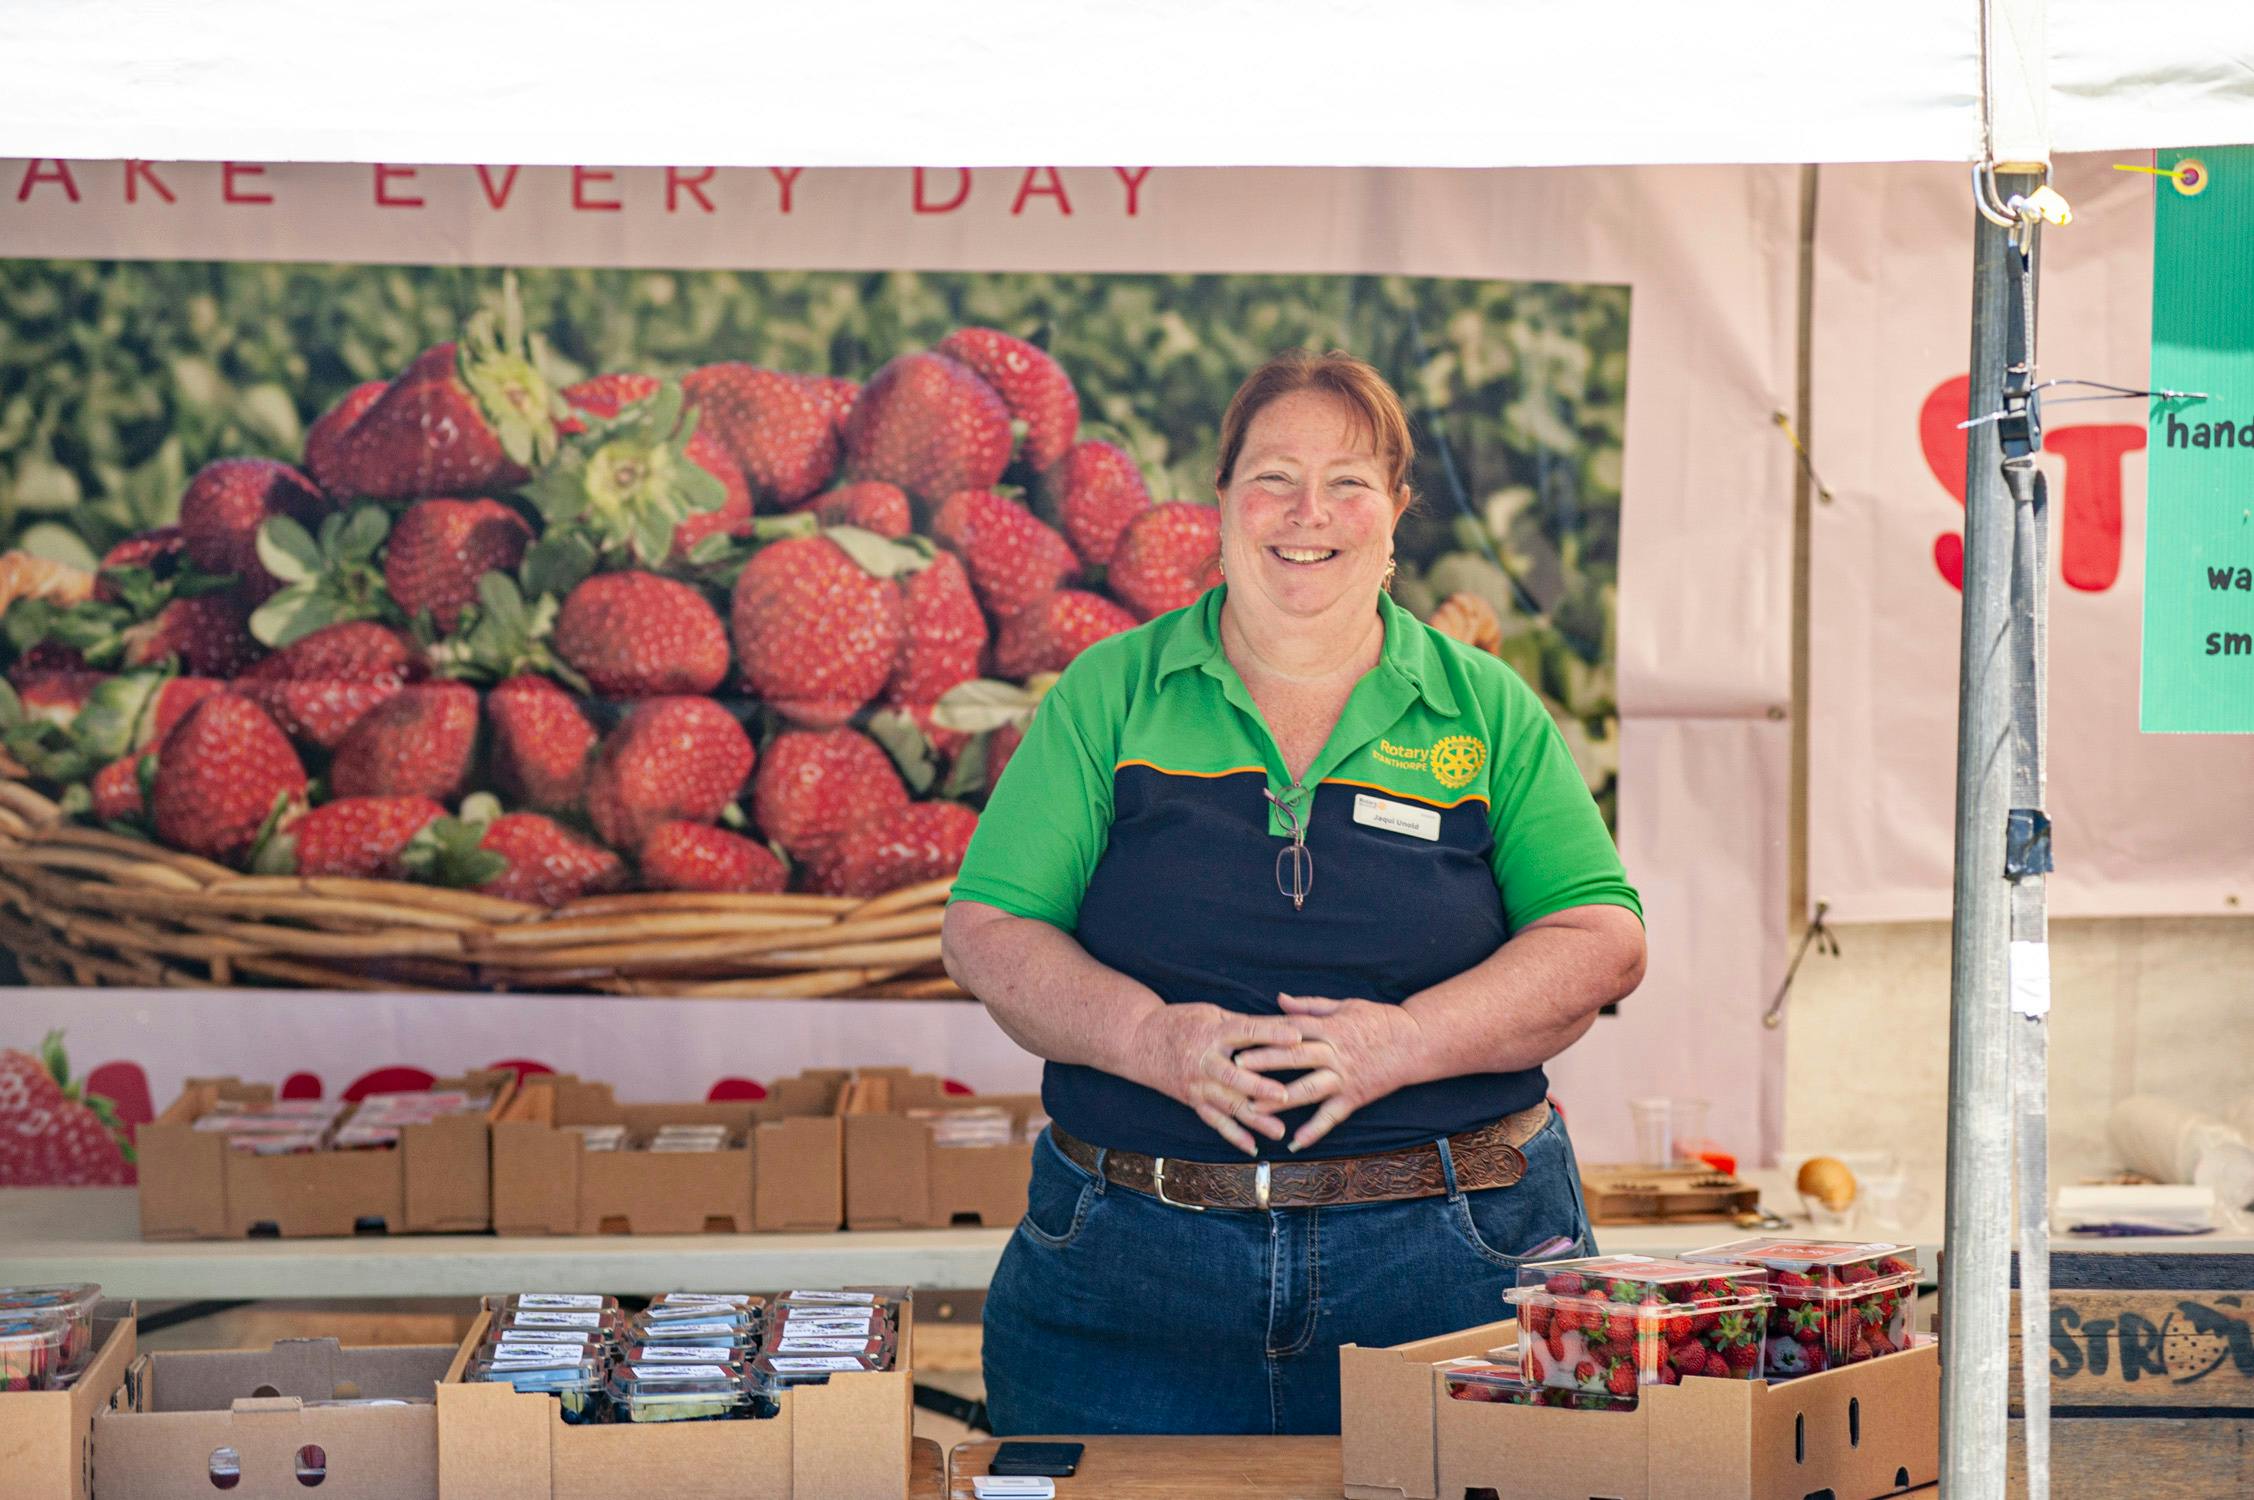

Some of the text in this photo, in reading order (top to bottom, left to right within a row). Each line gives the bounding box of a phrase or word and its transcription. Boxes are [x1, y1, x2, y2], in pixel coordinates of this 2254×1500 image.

[375, 163, 803, 214] EVERY
[912, 166, 1154, 216] DAY
[1380, 739, 1429, 762] Rotary
